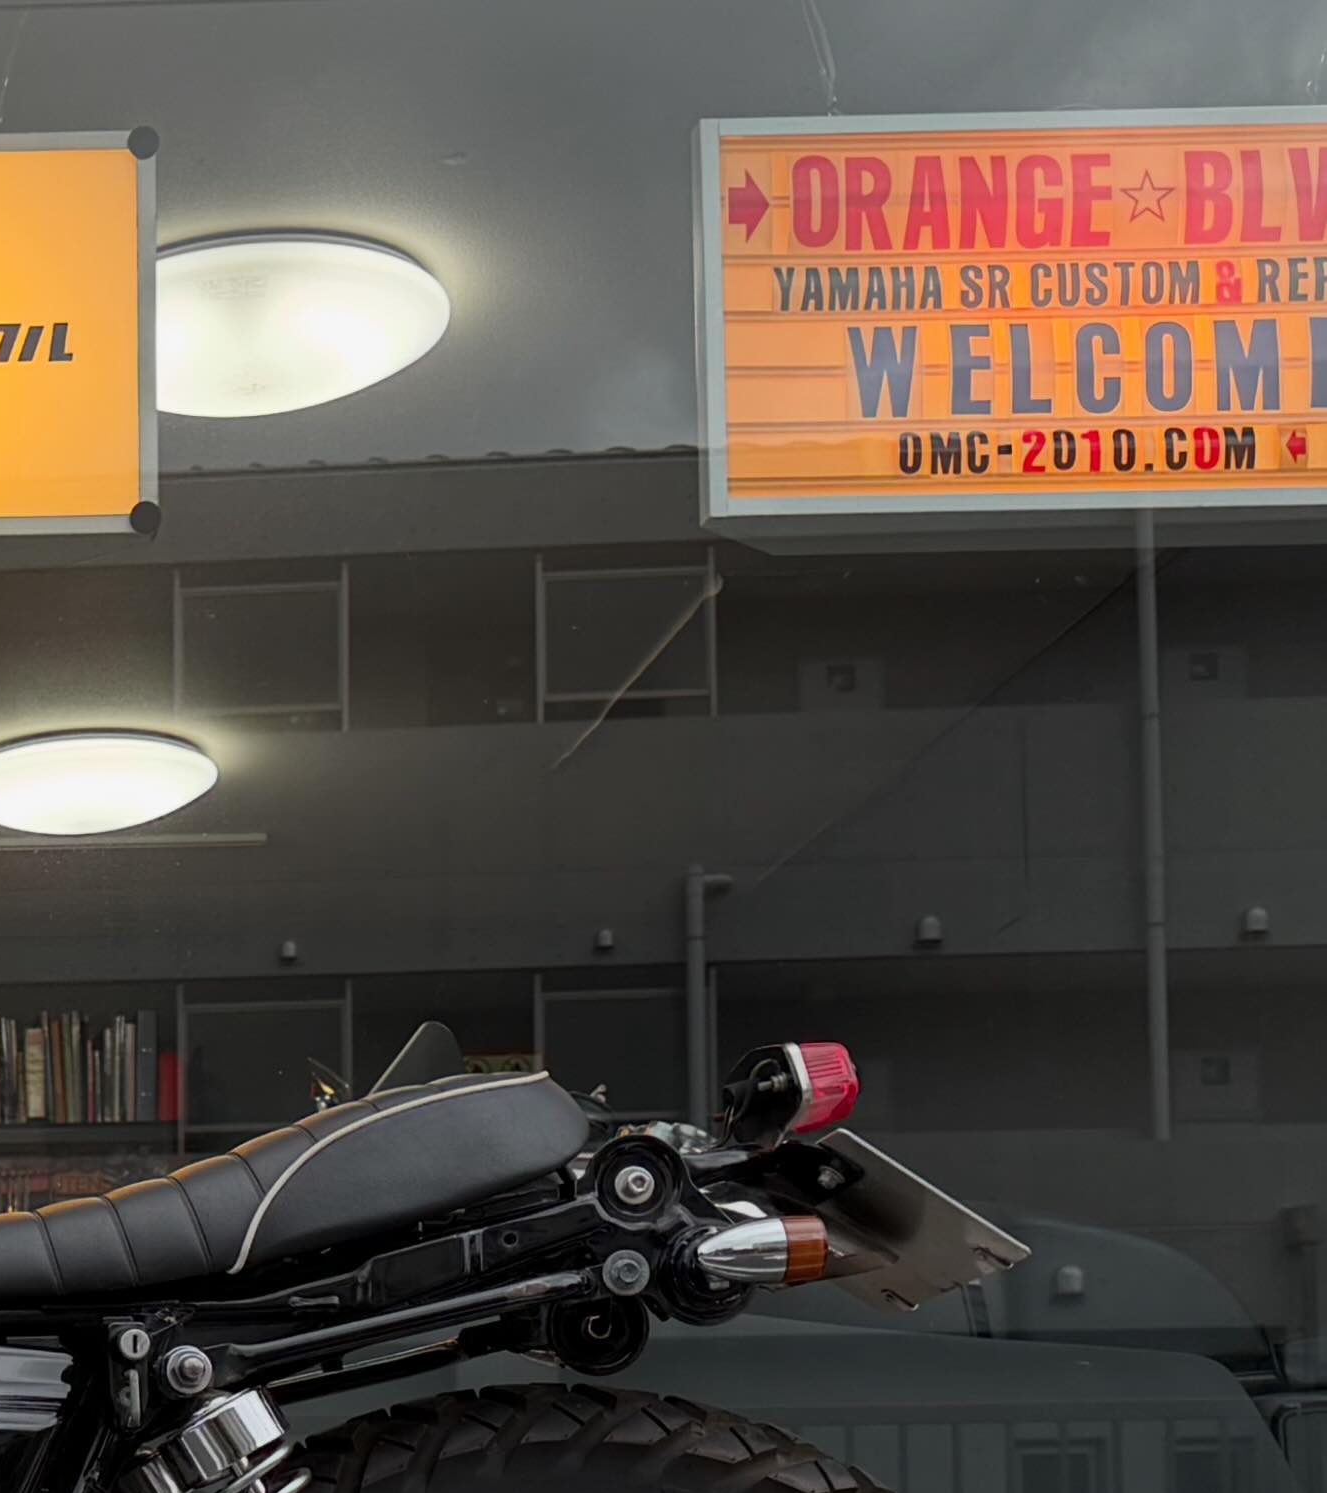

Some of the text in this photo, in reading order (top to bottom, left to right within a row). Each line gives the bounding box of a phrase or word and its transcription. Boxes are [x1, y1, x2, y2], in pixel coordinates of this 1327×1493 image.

[791, 153, 1112, 250] ORANGE
[774, 265, 943, 311] YAMAHA
[960, 264, 1011, 310] SR
[1030, 260, 1201, 307] CUSTOM
[1216, 260, 1243, 304] &
[899, 425, 1256, 475] OMC-2010.COM
